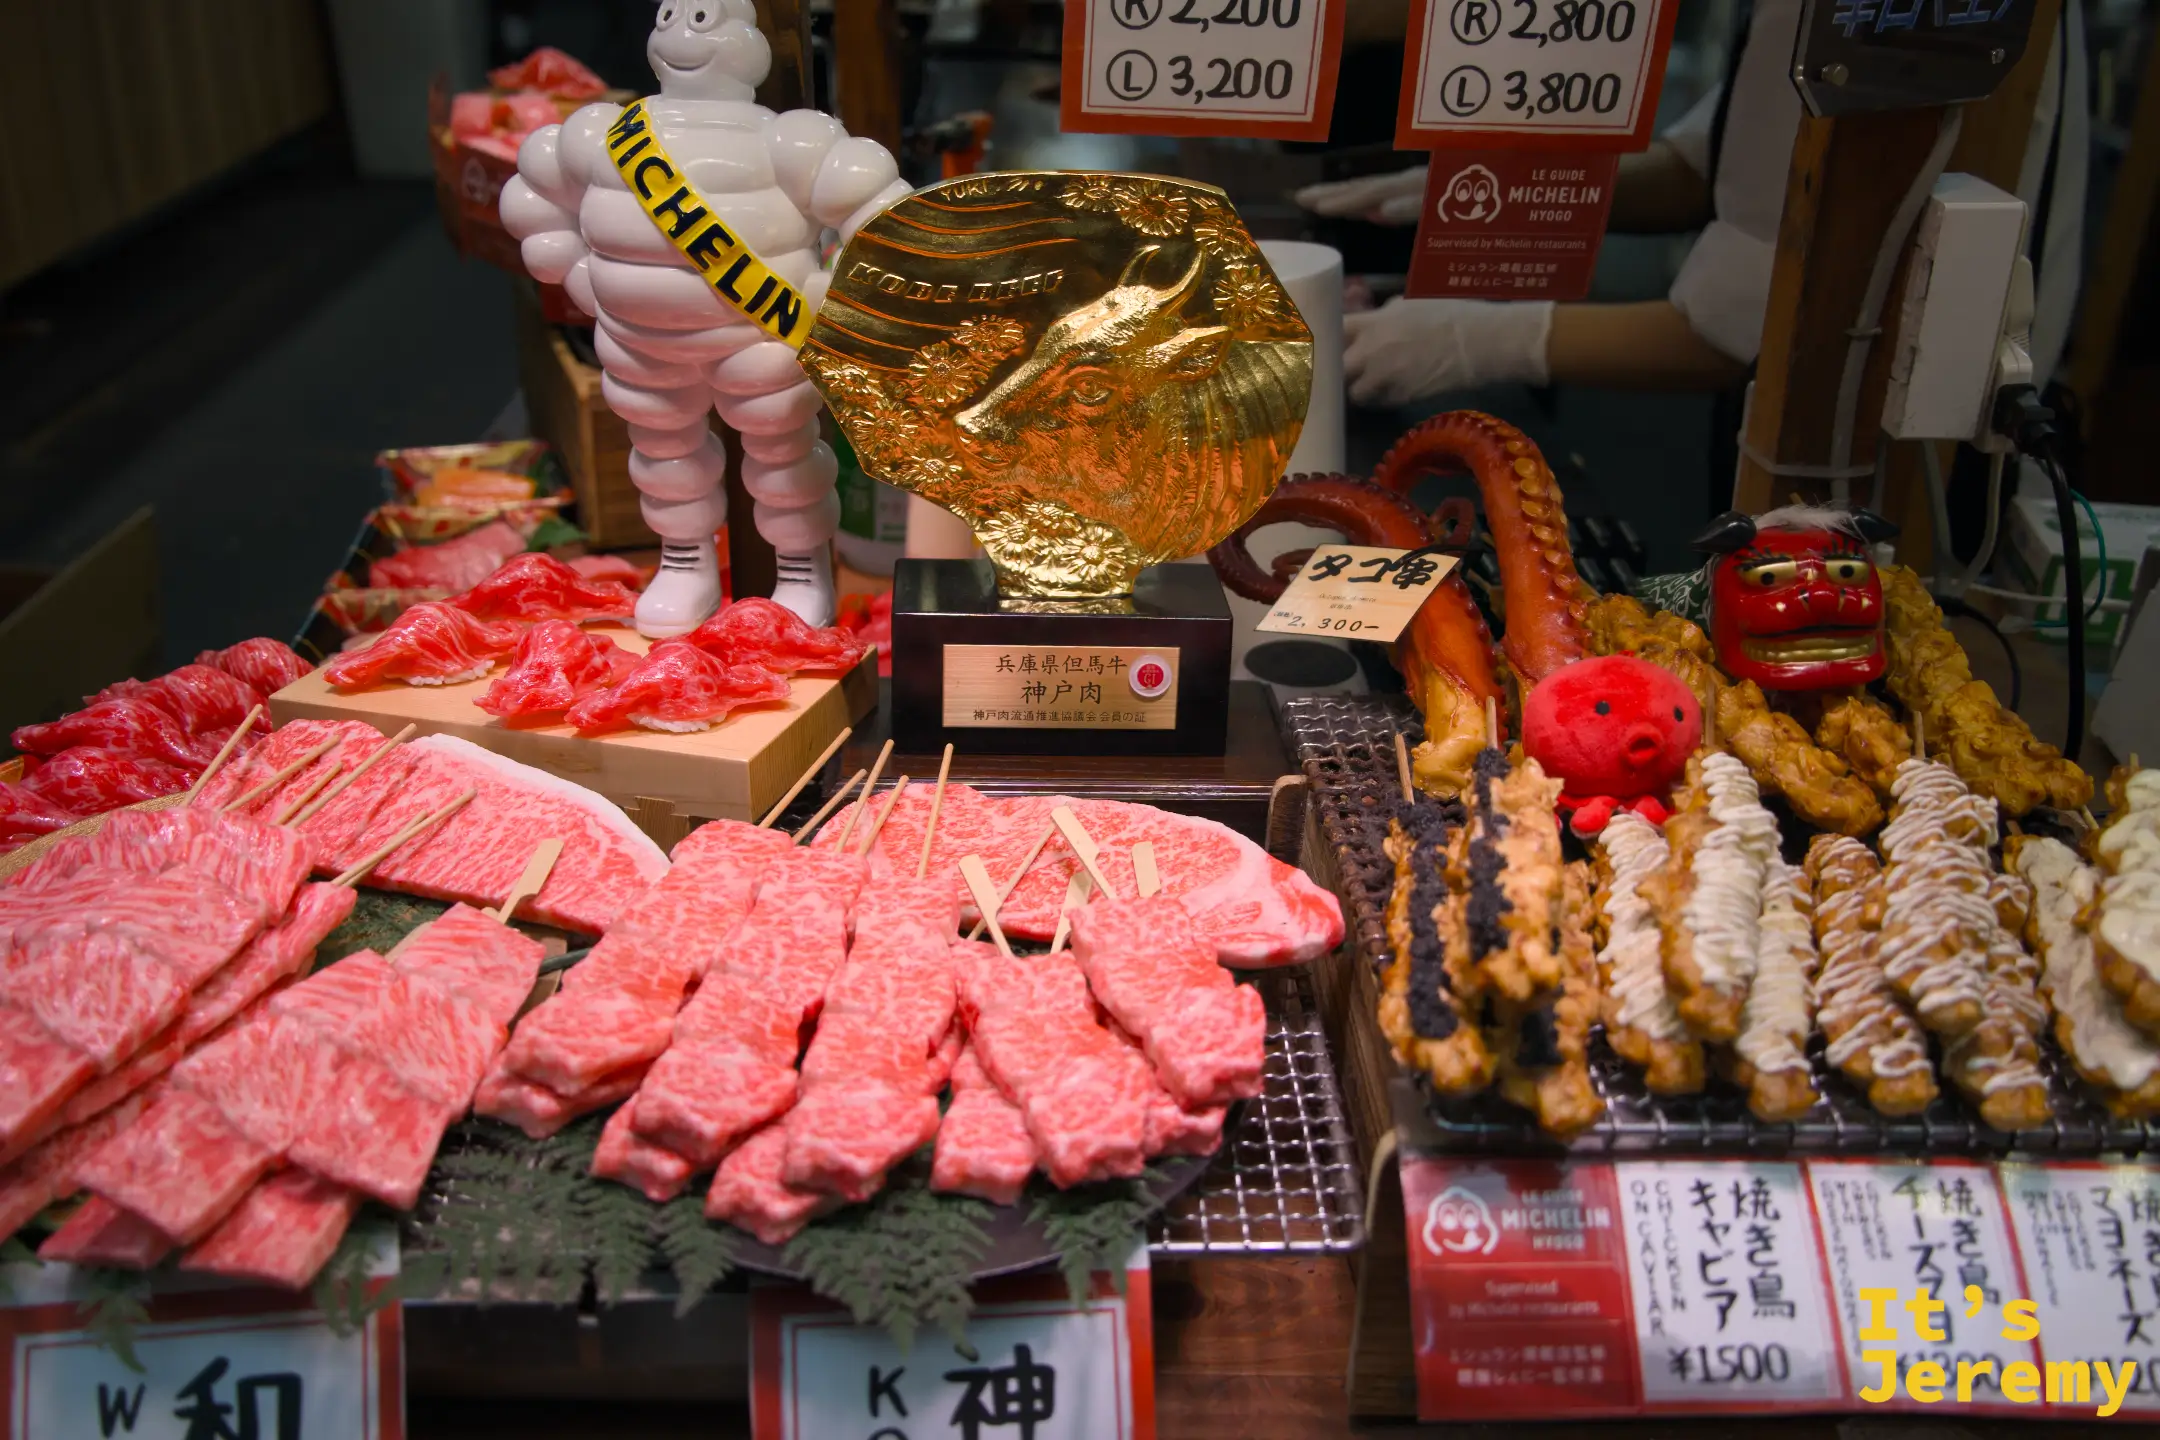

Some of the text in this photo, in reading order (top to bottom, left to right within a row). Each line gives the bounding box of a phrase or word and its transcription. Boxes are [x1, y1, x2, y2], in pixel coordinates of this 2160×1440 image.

[1508, 0, 1636, 48] 2,800
[1168, 55, 1293, 104] 3,200
[1504, 70, 1621, 120] 3,800
[1532, 169, 1586, 181] LE GUIDE
[1508, 186, 1601, 204] MICHELIN
[608, 103, 802, 339] MICHELIN
[1529, 210, 1572, 222] HYOGO
[1427, 237, 1586, 250] Supervised by Michelin restaurants
[847, 262, 959, 303] KOBE
[996, 654, 1128, 676] 兵庫県但馬牛
[1020, 680, 1102, 705] 神戸肉
[973, 710, 1147, 724] 神戸肉流通推進協議会 会員の証
[1501, 1207, 1611, 1229] MICHELIN
[1729, 1176, 1796, 1318] 焼き鳥
[1668, 1344, 1791, 1384] ¥1500
